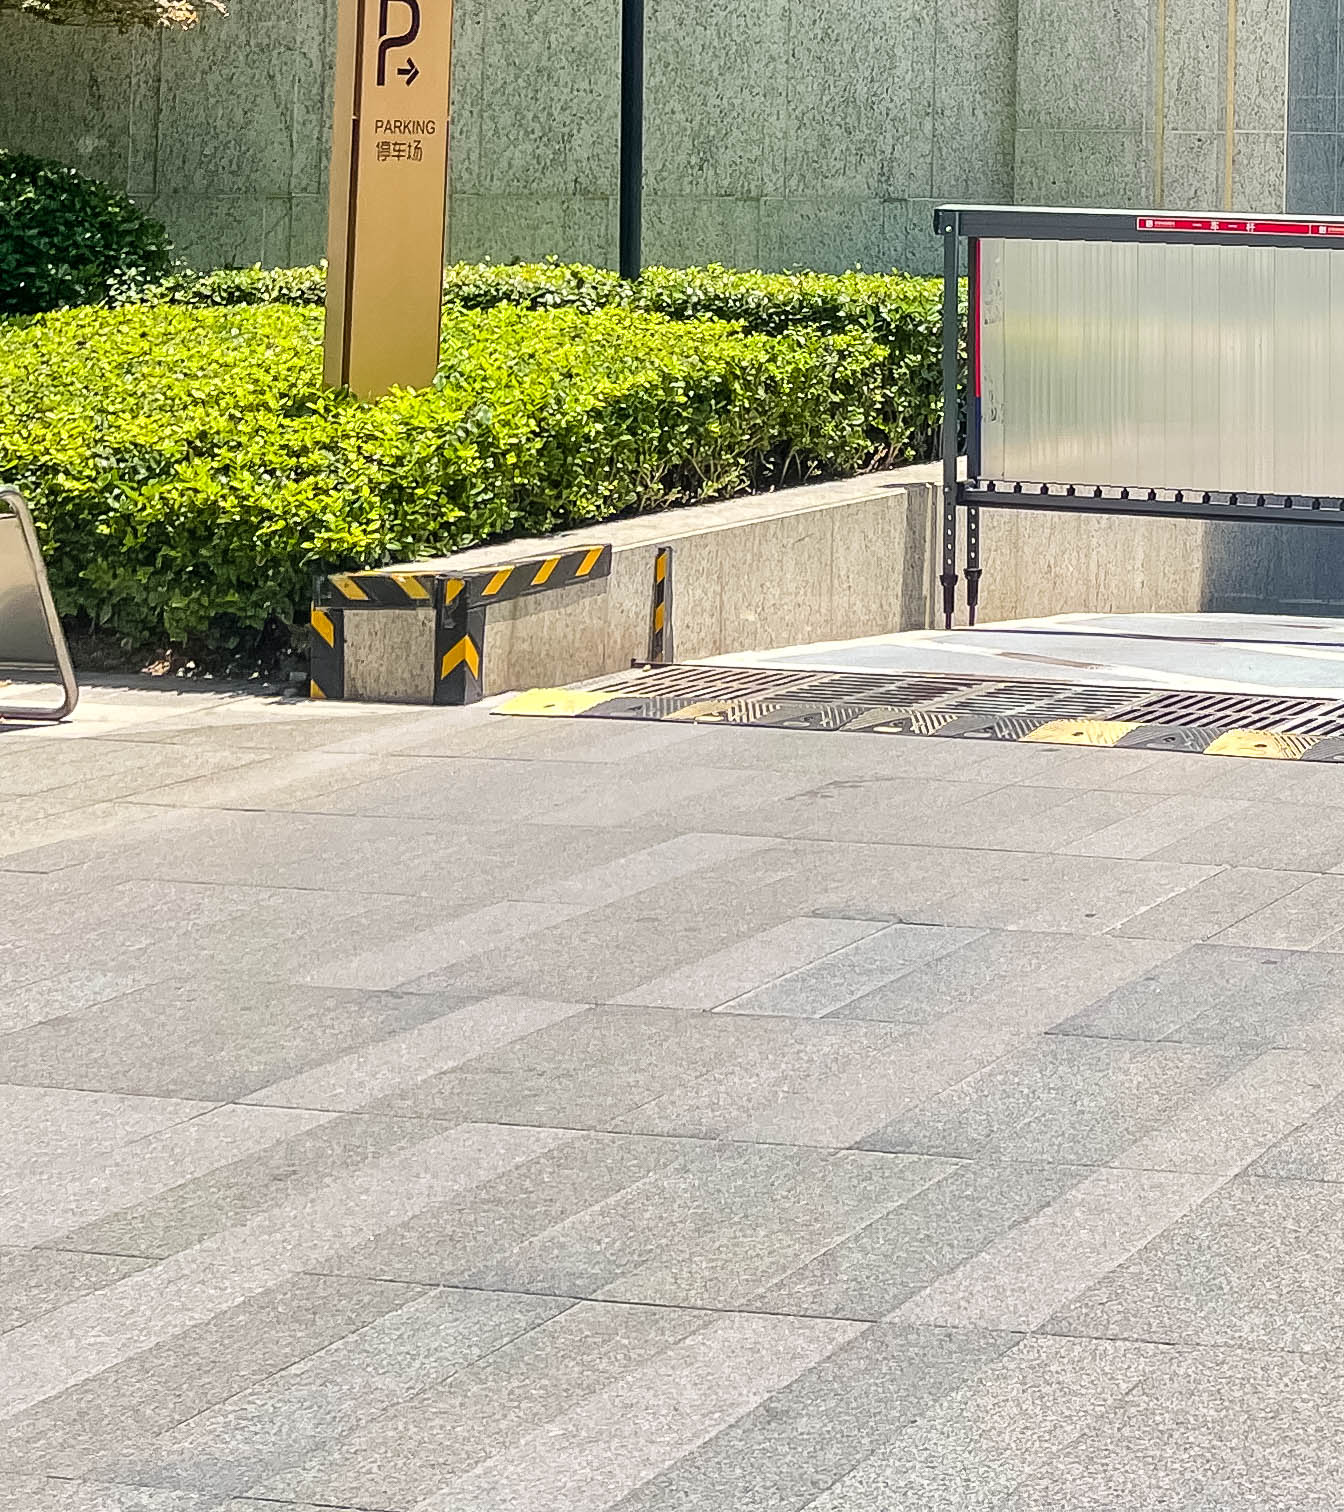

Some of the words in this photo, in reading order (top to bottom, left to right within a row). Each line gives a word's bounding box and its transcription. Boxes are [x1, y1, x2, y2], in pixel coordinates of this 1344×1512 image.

[374, 119, 436, 135] PARKING
[376, 140, 424, 162] 停车场
